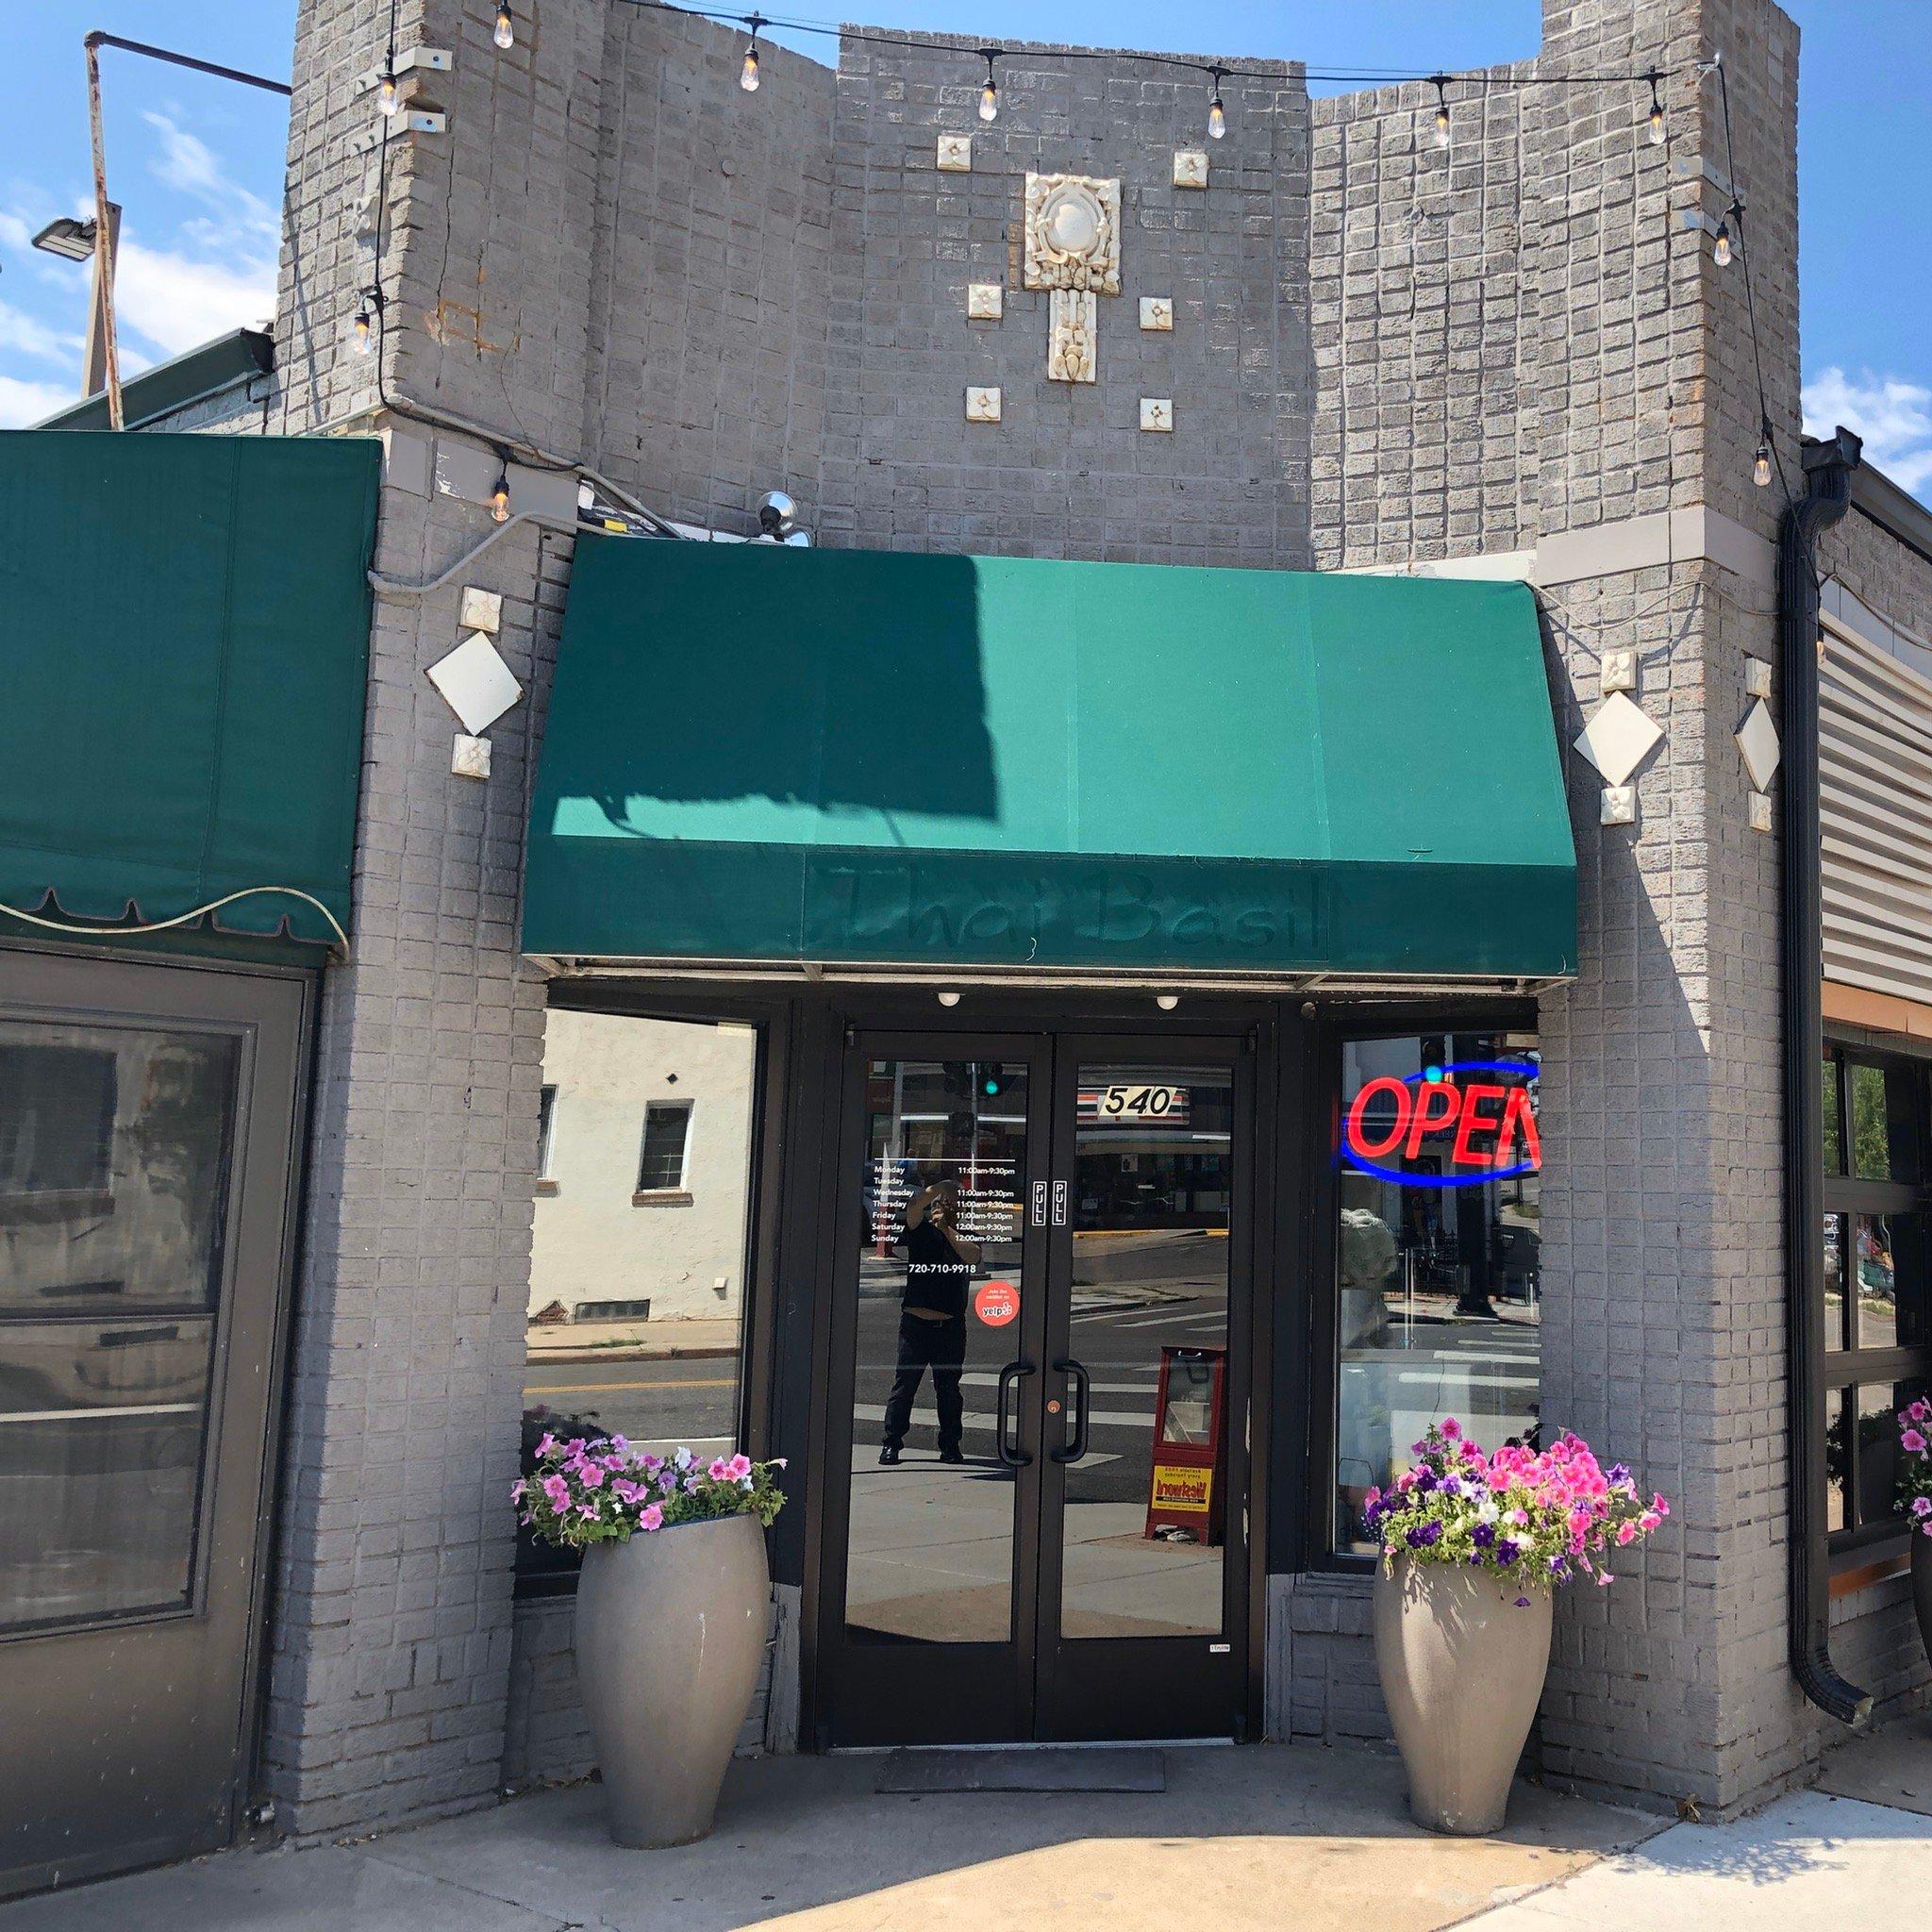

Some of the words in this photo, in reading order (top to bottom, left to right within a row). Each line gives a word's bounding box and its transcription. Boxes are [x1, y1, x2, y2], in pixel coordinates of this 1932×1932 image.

[1105, 1088, 1170, 1114] 540
[874, 1165, 905, 1175] Monday
[958, 1166, 1016, 1175] 11:00am-9:30pm
[874, 1177, 905, 1186] Tuesday
[873, 1189, 914, 1198] Wednesday
[957, 1189, 1014, 1198] 11:00am-9:30pm
[873, 1200, 908, 1209] Thursday
[956, 1200, 1014, 1209] 11:00am-9:30pm
[1035, 1184, 1044, 1224] PULL
[1055, 1183, 1064, 1223] PULL
[872, 1211, 896, 1221] Friday
[956, 1212, 1013, 1221] 11:00am-9:30pm
[872, 1224, 906, 1232] Saturday
[955, 1224, 1013, 1232] 12:00am-9:30pm
[871, 1235, 899, 1243] Sunday
[955, 1235, 1012, 1243] 12:00am-9:30pm
[908, 1264, 976, 1274] 720-710-9918
[982, 1307, 1003, 1317] yelp
